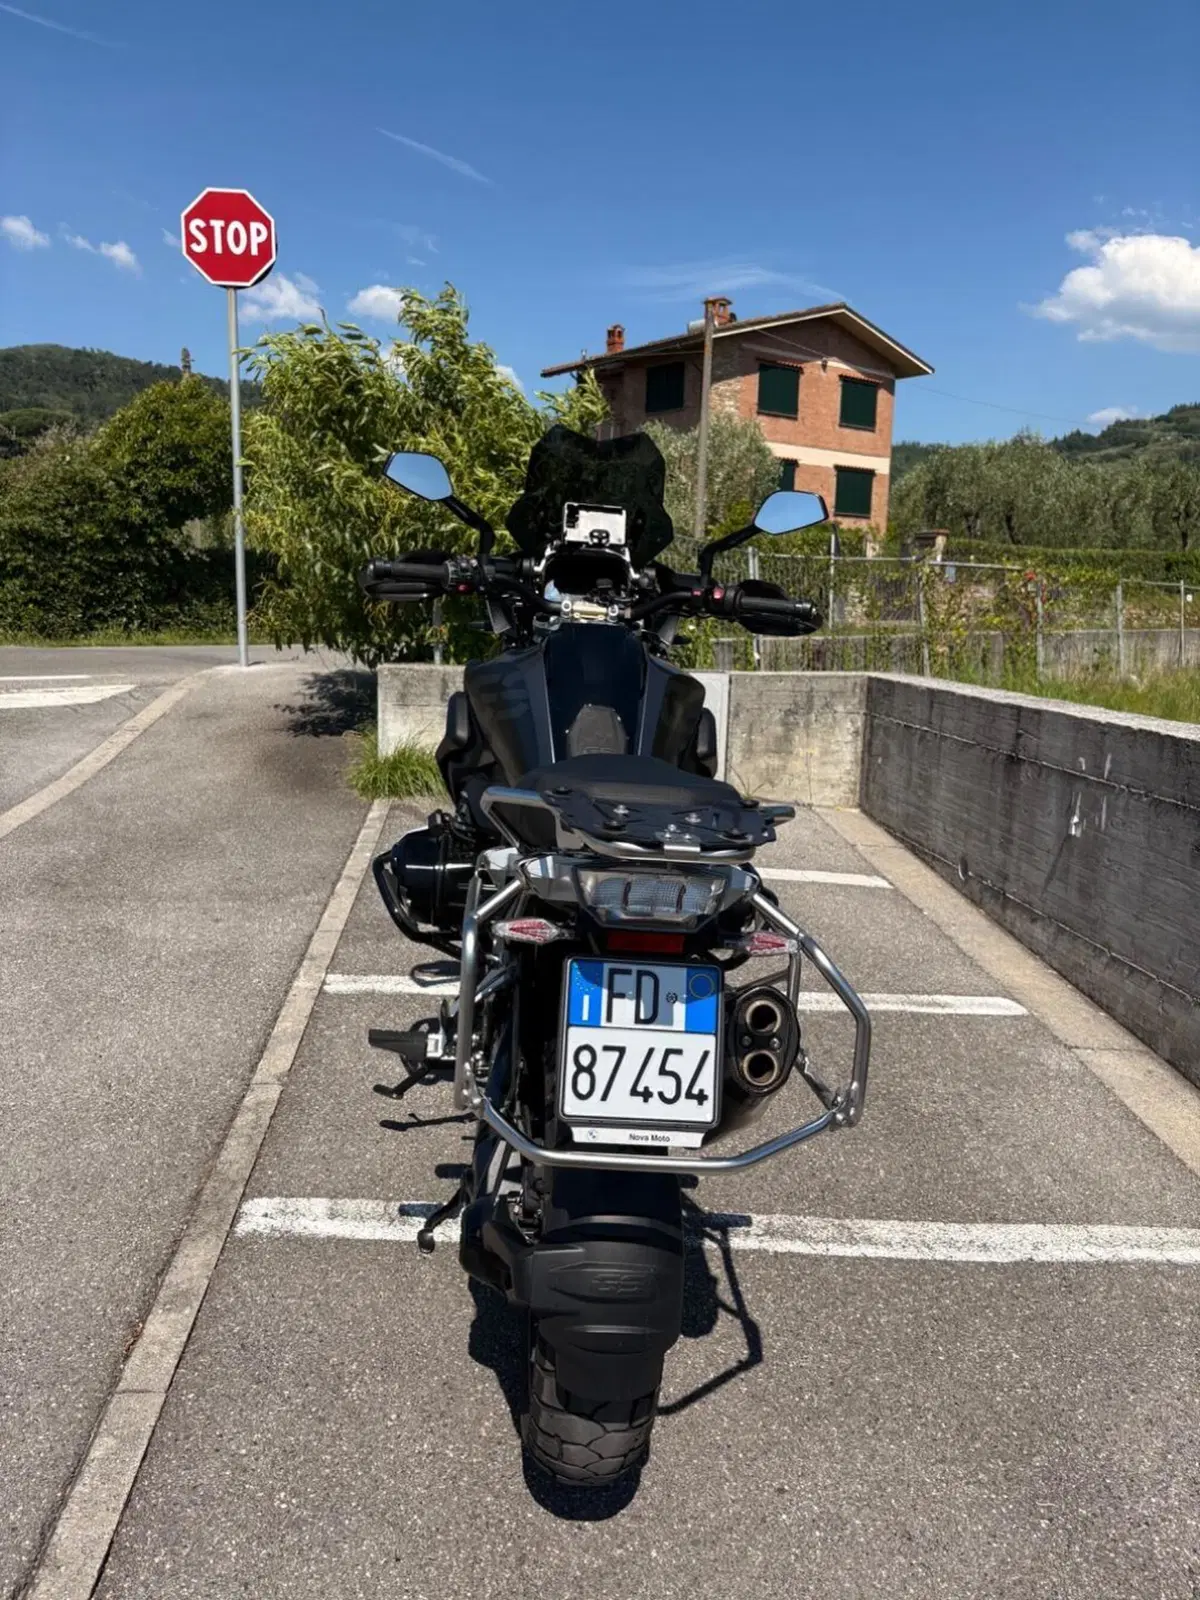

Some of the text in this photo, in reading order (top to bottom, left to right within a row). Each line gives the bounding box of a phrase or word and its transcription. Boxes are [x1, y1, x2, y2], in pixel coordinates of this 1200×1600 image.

[189, 218, 268, 256] STOP
[606, 968, 660, 1025] FD
[571, 1044, 711, 1106] 87454
[629, 1133, 671, 1142] Nova Moto
